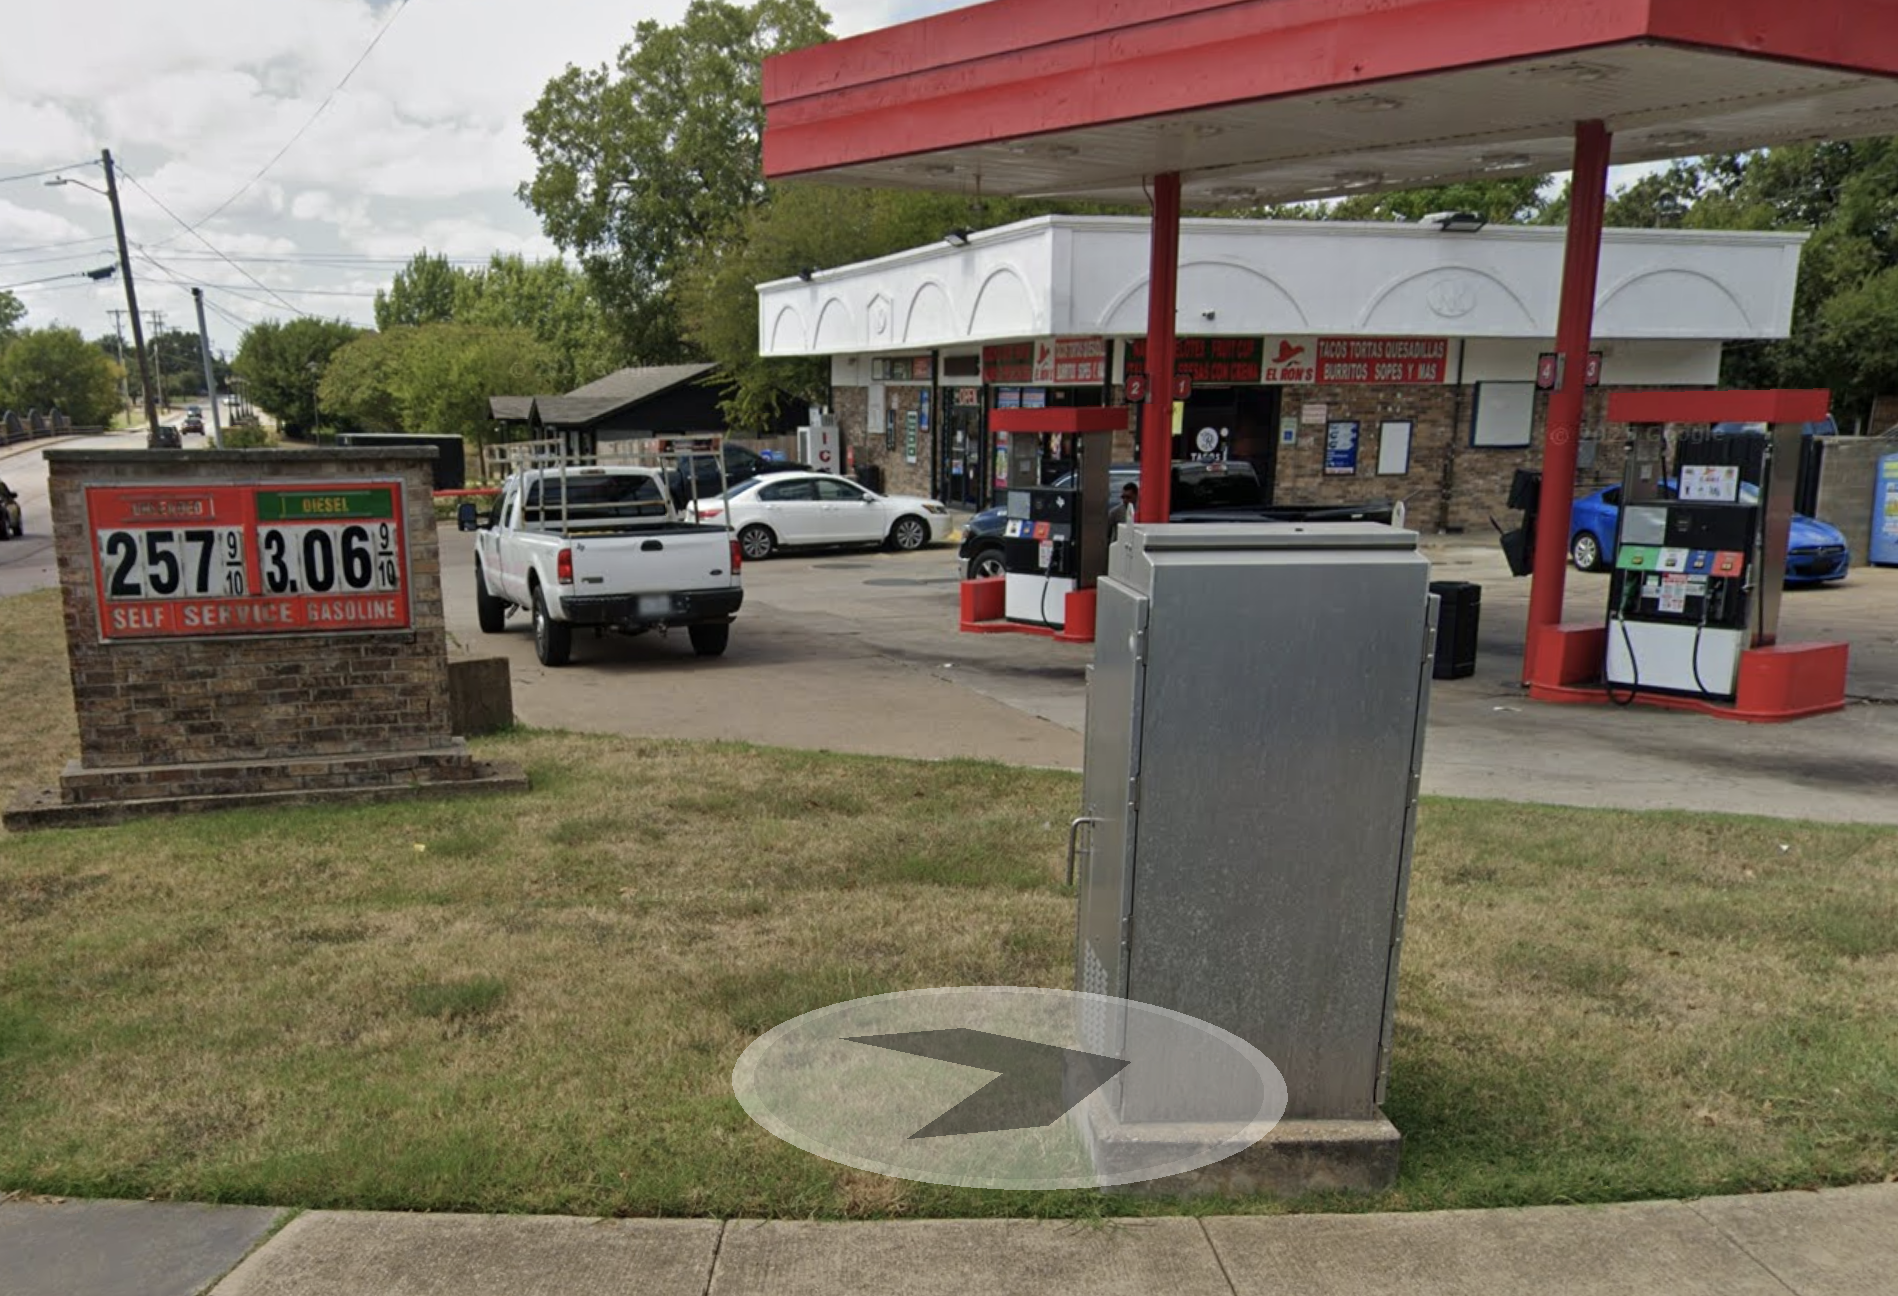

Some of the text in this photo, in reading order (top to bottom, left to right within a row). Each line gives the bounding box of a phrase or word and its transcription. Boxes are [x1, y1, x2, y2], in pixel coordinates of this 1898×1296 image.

[1319, 341, 1444, 359] TACOS TORTAS QUESADILLAS
[1265, 368, 1278, 381] EL
[1323, 363, 1368, 380] BURRITOS
[1374, 363, 1403, 380] SOPES
[1407, 363, 1415, 380] Y
[1130, 381, 1141, 395] 2
[1178, 379, 1186, 394] 1
[302, 497, 350, 513] DIESEL
[263, 525, 373, 594] 3.06
[111, 599, 397, 629] SELF SERVICE GASOLINE
